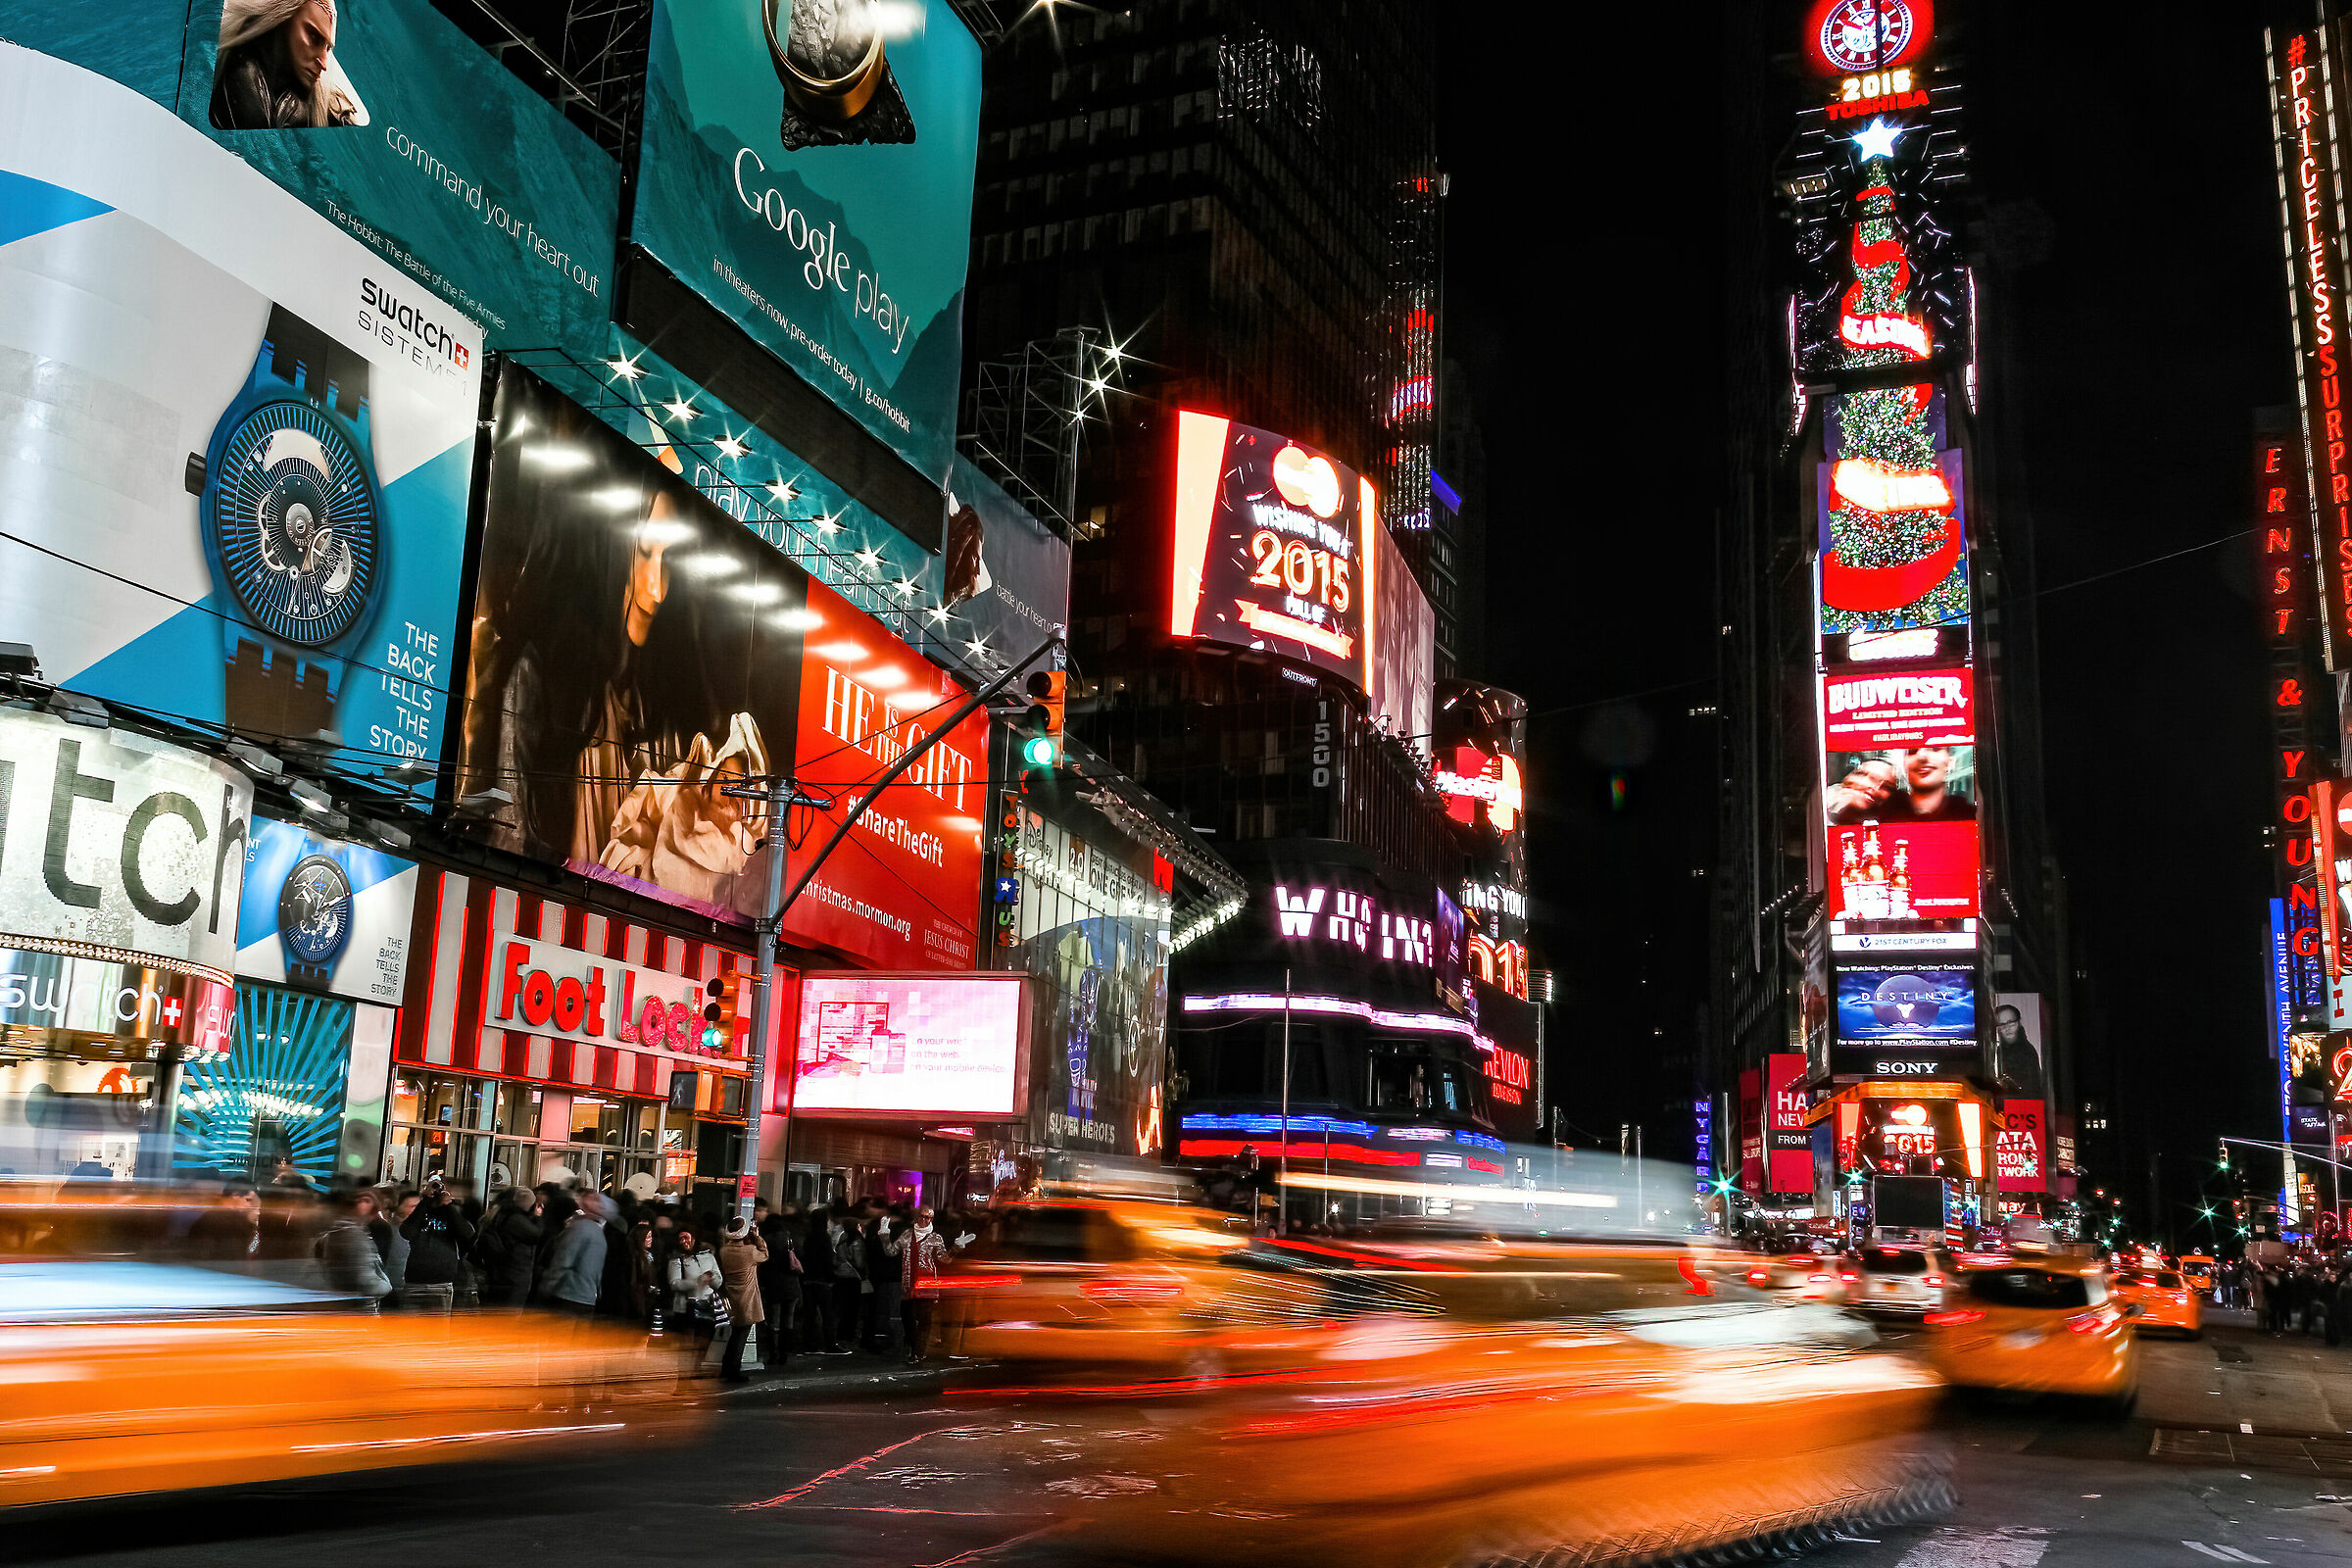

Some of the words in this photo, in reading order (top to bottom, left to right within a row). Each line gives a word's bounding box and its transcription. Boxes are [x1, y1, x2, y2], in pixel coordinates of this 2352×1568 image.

[1825, 89, 1931, 121] TOSHIBA
[1842, 69, 1911, 102] 2015
[386, 126, 482, 210] command
[483, 198, 524, 239] your
[526, 222, 571, 275] heart
[572, 265, 600, 298] out
[327, 200, 346, 224] The
[385, 239, 403, 262] The
[404, 253, 431, 280] Battle
[431, 274, 443, 288] of
[443, 280, 457, 299] the
[459, 290, 475, 310] Five
[475, 303, 506, 330] Armies
[734, 147, 851, 292] Google
[855, 269, 910, 355] play
[361, 277, 452, 361] swatch
[713, 254, 723, 277] in
[724, 265, 765, 311] theaters
[766, 303, 790, 333] now,
[790, 322, 833, 367] pre-order
[833, 357, 858, 390] today
[865, 387, 910, 433] g.co/hobbit
[2265, 448, 2294, 635] ERNST
[815, 529, 874, 610] heart
[877, 585, 910, 634] out
[1250, 529, 1350, 613] 2015
[405, 621, 439, 658] THE
[387, 643, 436, 685] BACK
[379, 667, 432, 711] TELLS
[1828, 676, 1968, 714] BUDWEISER
[2277, 678, 2303, 707] &
[369, 724, 428, 760] STORY
[396, 706, 430, 740] THE
[821, 665, 875, 757] HE
[885, 699, 899, 738] IS
[906, 723, 972, 812] GIFT
[1313, 701, 1331, 788] 1500
[0, 737, 253, 949] tch
[847, 794, 944, 868] #ShareTheGift
[2282, 751, 2320, 956] YOUNG
[801, 879, 911, 942] hristmas.mormon.org
[379, 948, 401, 960] BACK
[387, 937, 403, 949] THE
[924, 929, 943, 950] JESUS
[945, 938, 970, 959] CHRIST
[1892, 937, 1930, 946] CENTURY
[376, 958, 399, 973] TELLS
[383, 973, 398, 986] THE
[370, 983, 397, 997] STORY
[494, 941, 606, 1037] Foot
[1861, 991, 1949, 1002] DESTINY
[1483, 1045, 1530, 1090] REVLON
[1876, 1061, 1938, 1074] SONY
[1050, 1112, 1080, 1137] SUPER
[1778, 1135, 1806, 1145] FROM
